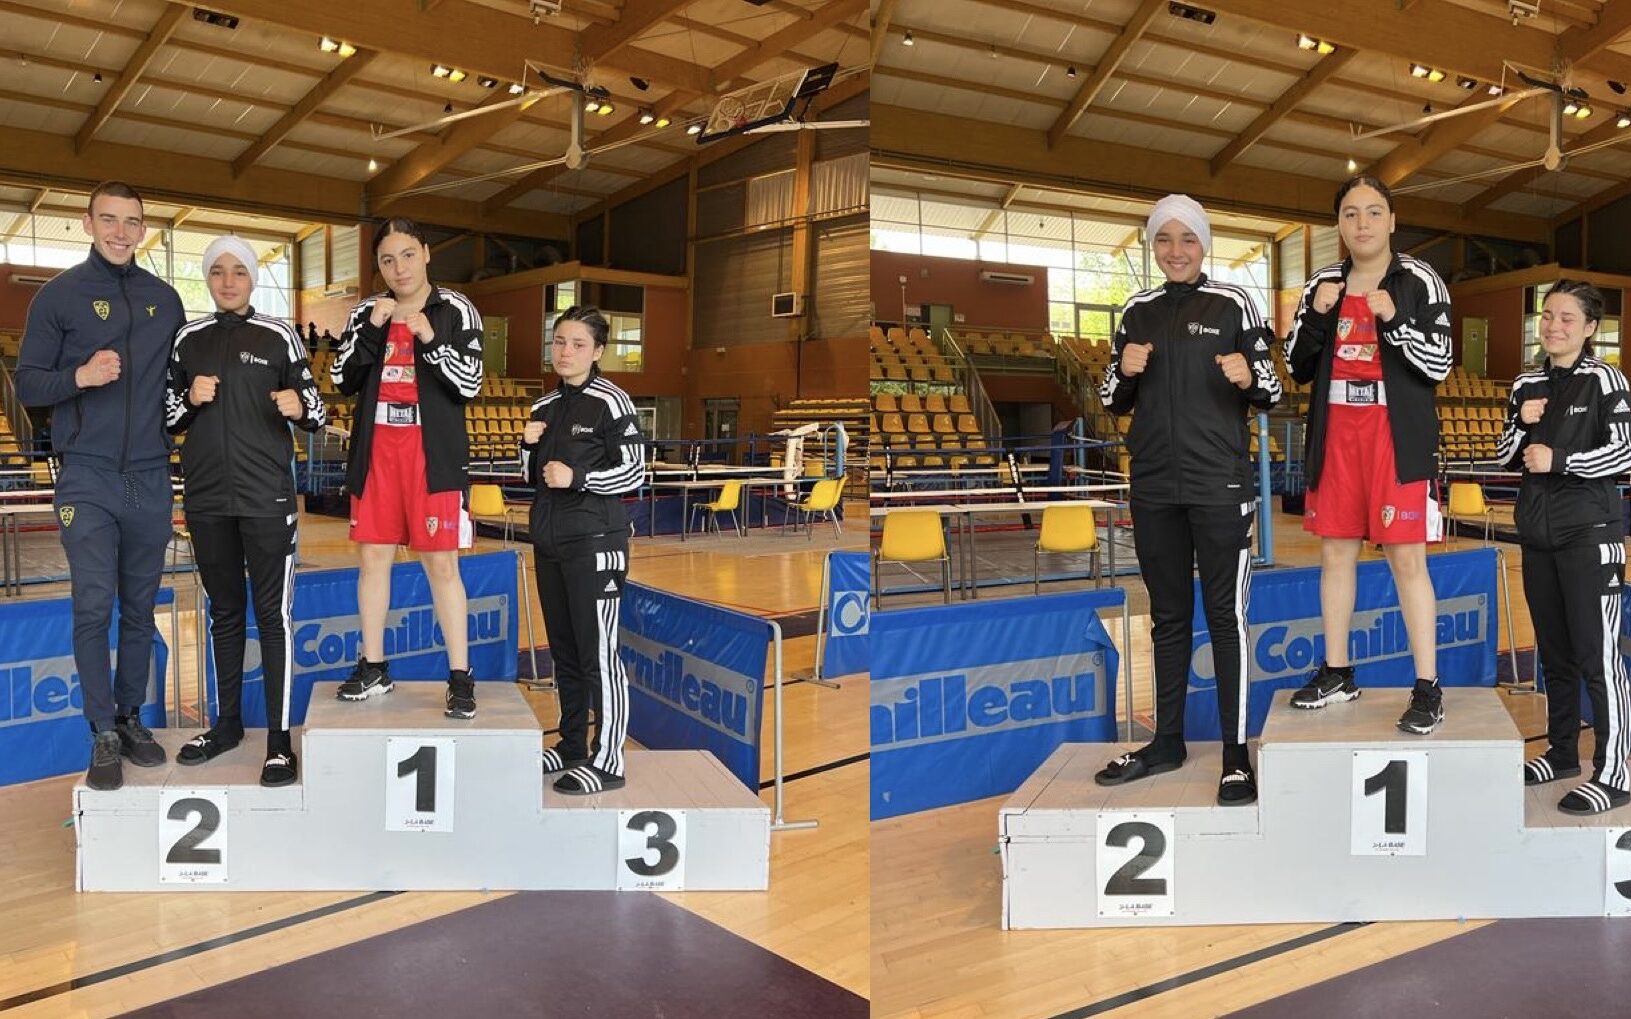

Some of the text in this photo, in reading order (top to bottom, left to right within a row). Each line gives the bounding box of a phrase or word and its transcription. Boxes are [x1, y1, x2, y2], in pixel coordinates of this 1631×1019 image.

[397, 746, 438, 813] 1
[1364, 759, 1408, 834] 1
[166, 798, 222, 864] 2
[625, 811, 680, 876] 3
[1104, 821, 1168, 896] 2
